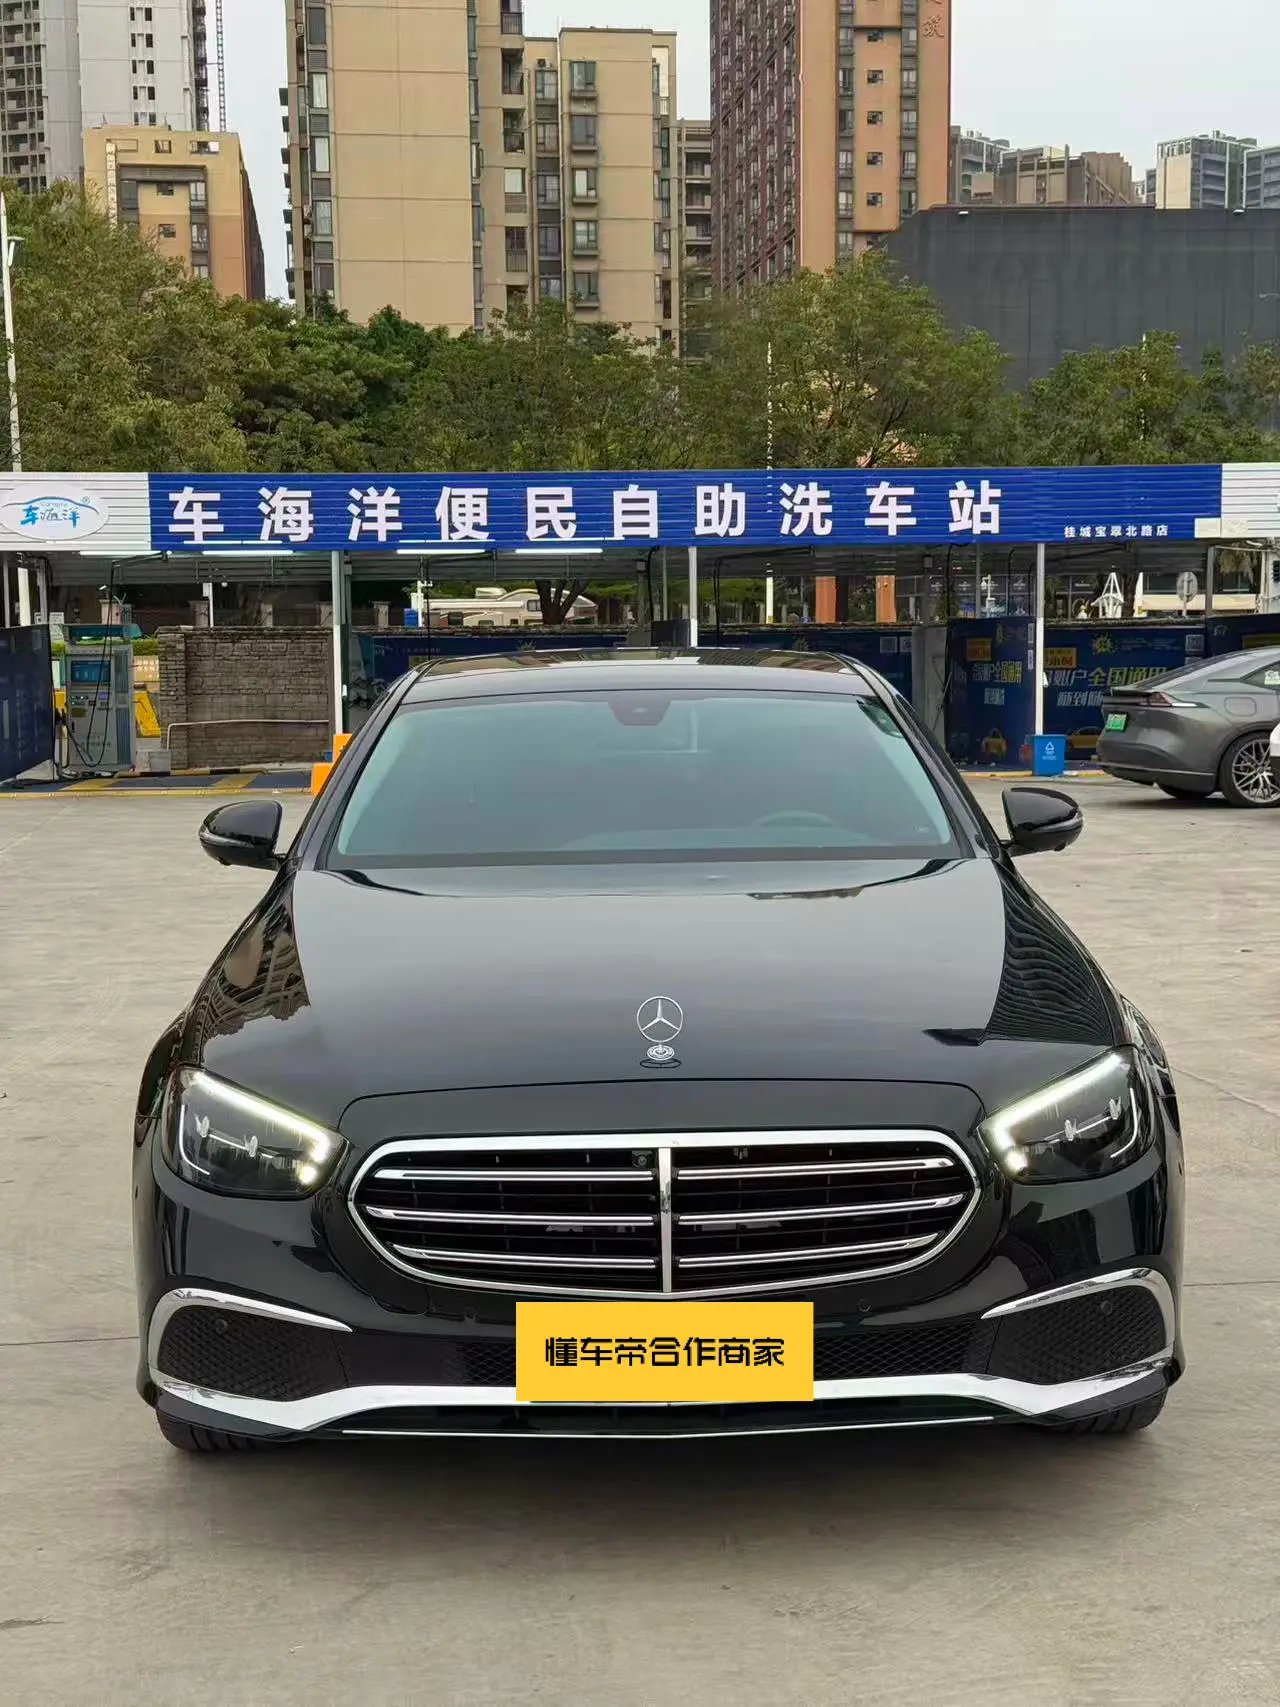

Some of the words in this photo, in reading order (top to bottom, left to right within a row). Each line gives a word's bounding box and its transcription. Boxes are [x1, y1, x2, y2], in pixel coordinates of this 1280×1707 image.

[20, 505, 80, 528] 车海洋
[168, 480, 1001, 542] 车海洋便民自助洗车站
[1064, 525, 1169, 538] 桂城宝翠北路店
